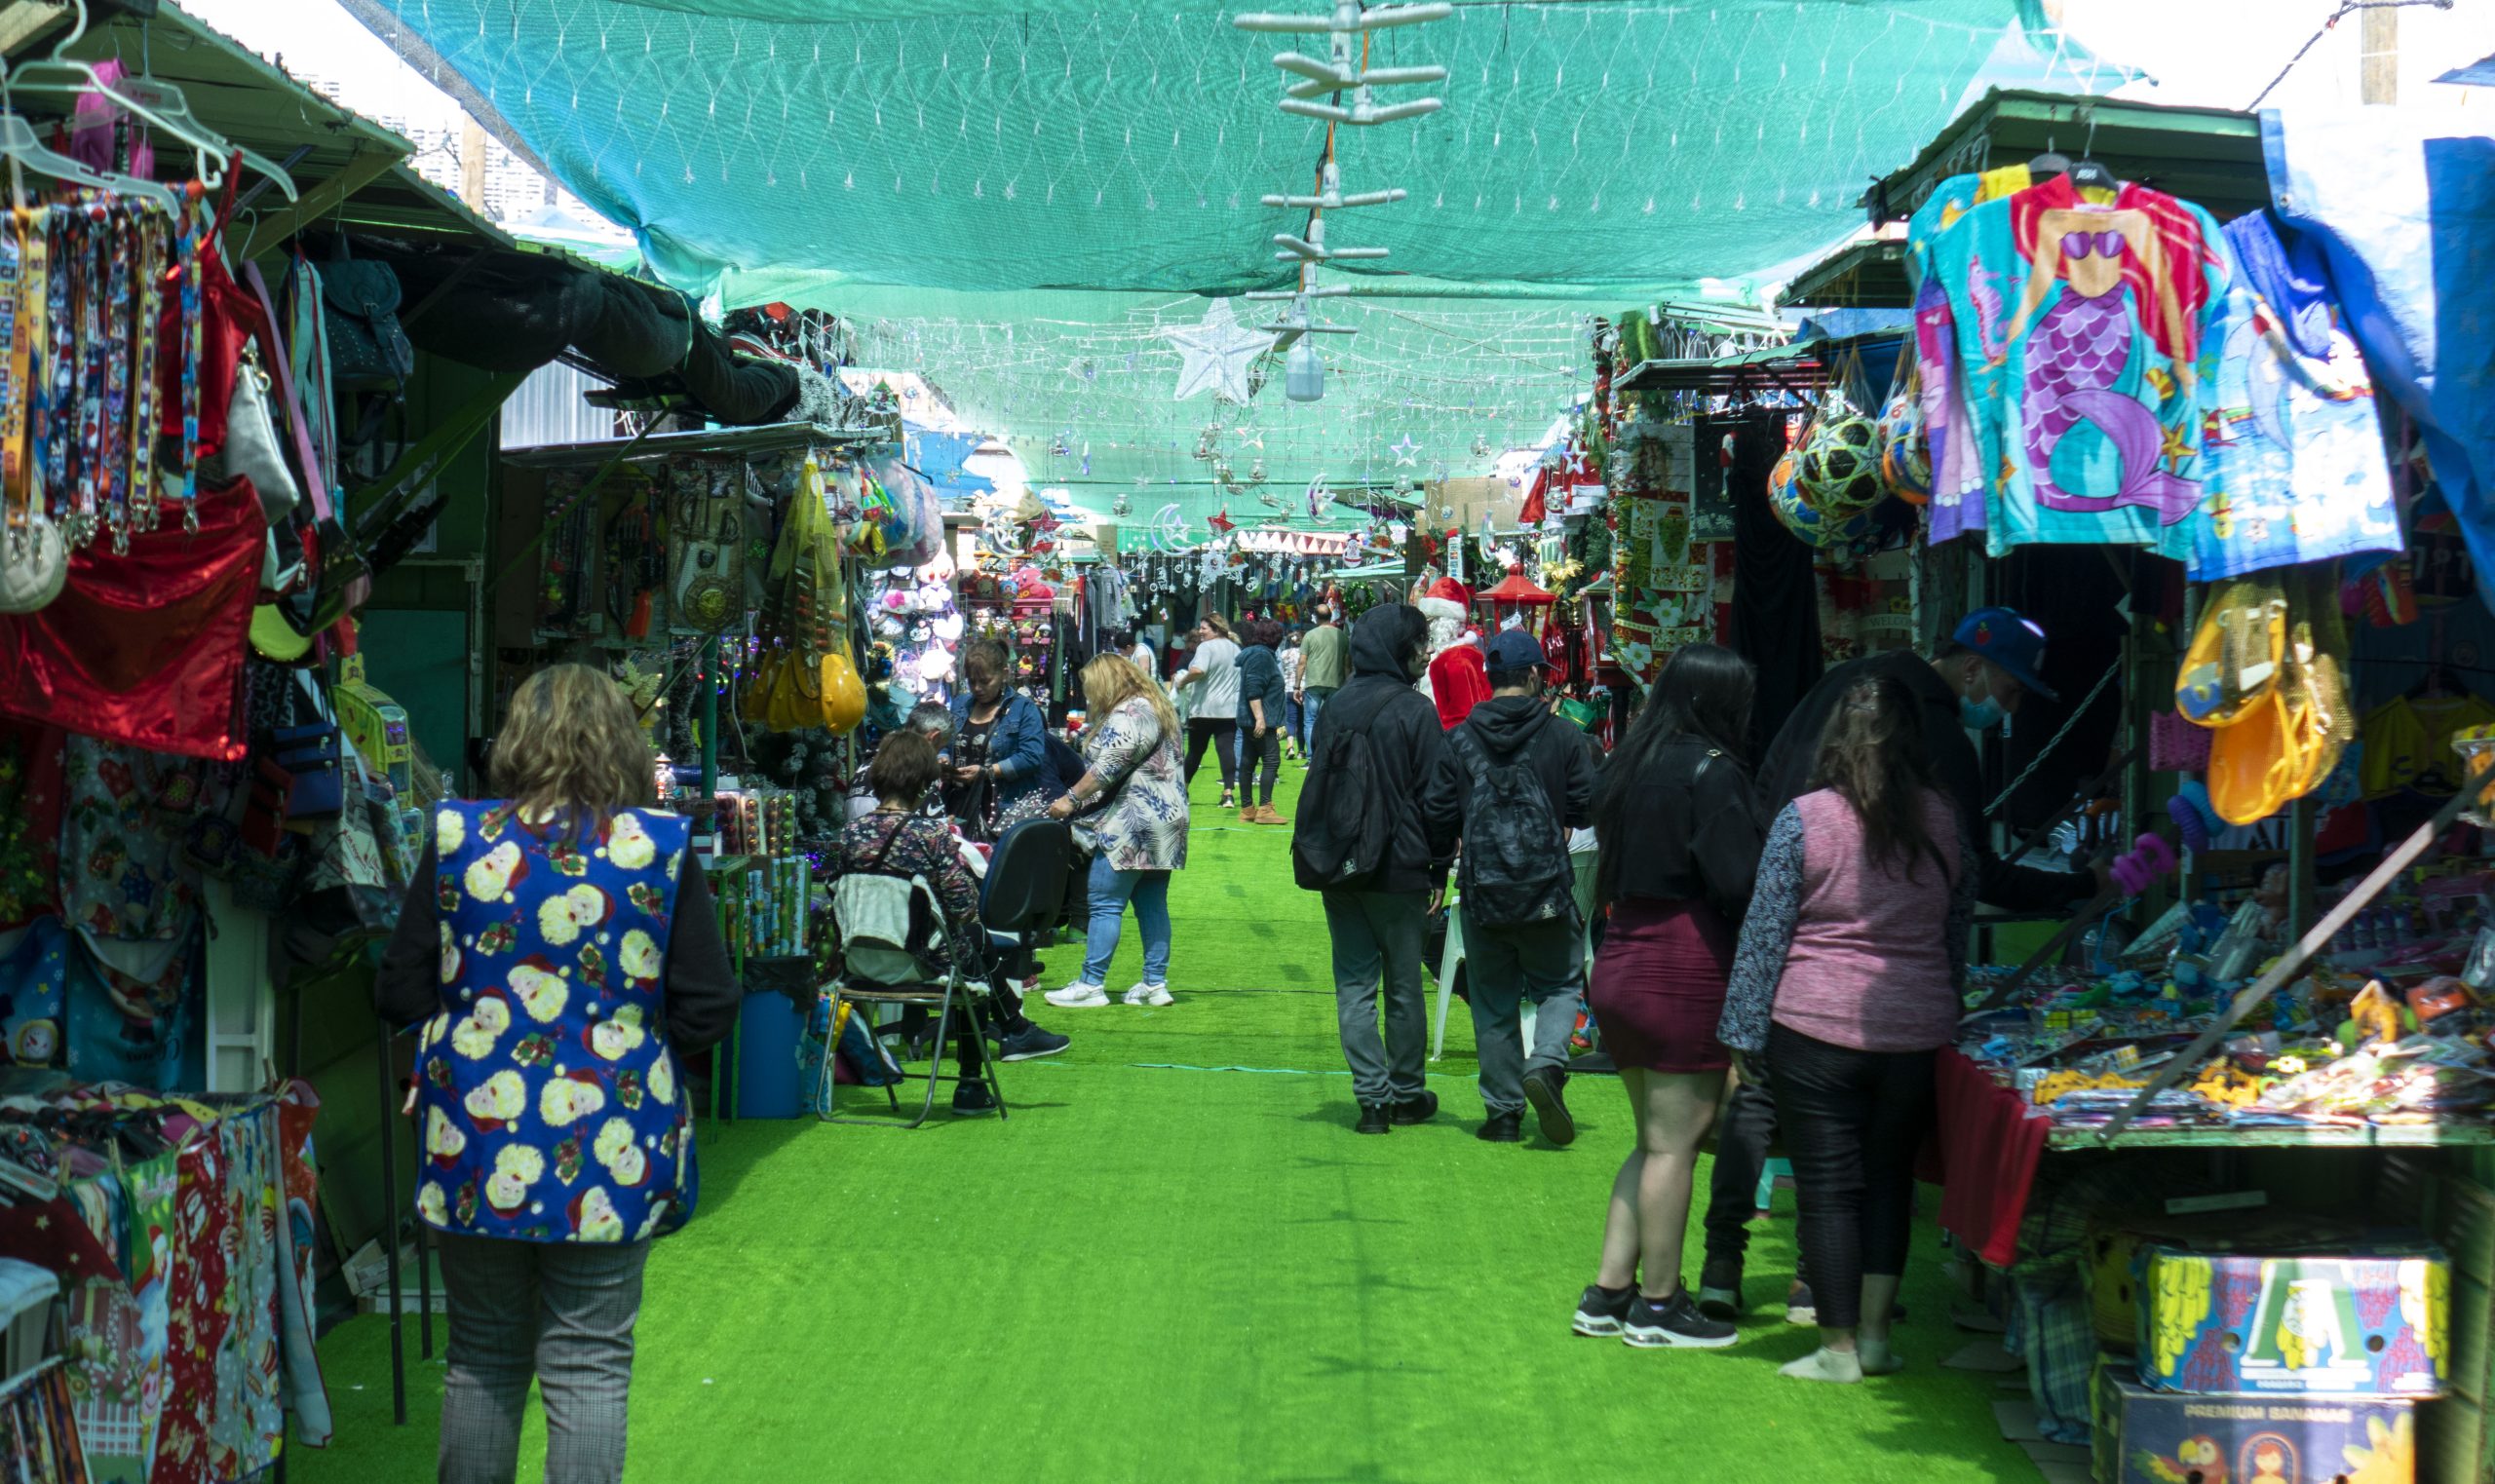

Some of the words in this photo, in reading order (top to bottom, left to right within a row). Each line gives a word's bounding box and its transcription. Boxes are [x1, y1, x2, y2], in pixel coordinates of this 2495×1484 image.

[1870, 616, 1911, 628] WELCO
[2184, 1404, 2265, 1420] PREMIUM
[2269, 1406, 2353, 1424] BANANAS
